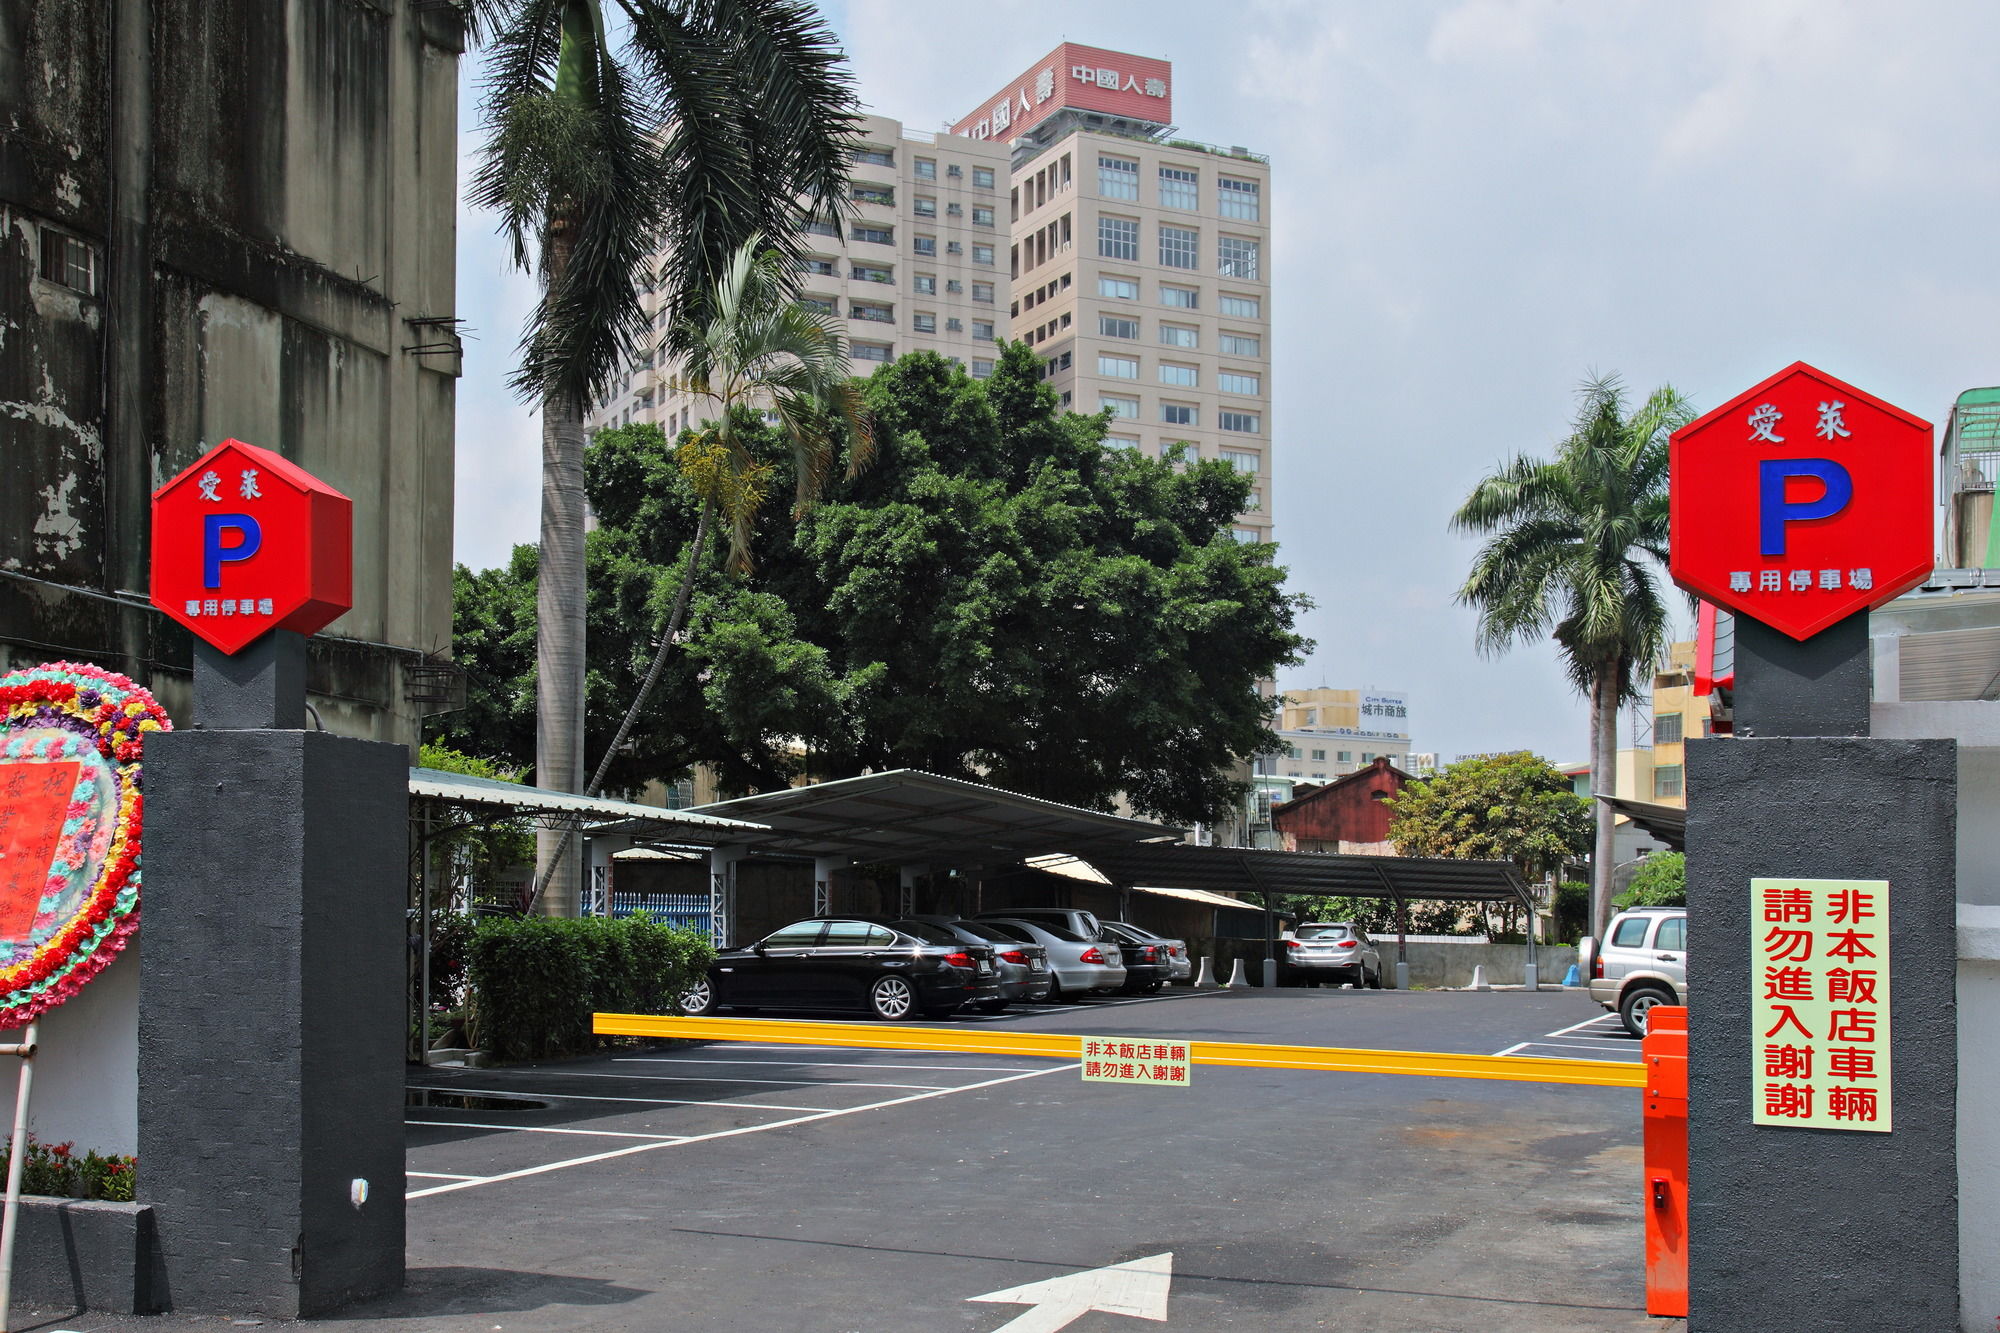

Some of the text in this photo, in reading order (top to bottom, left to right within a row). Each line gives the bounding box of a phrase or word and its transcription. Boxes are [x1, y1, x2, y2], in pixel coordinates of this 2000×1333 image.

[1072, 65, 1166, 98] 中國人壽
[972, 66, 1055, 141] 中國人壽
[1747, 399, 1852, 443] 愛萊
[198, 468, 263, 502] 愛萊
[1760, 458, 1853, 556] P
[204, 513, 262, 588] P
[1728, 568, 1874, 592] 專用停車場
[184, 598, 274, 617] 專用停車場
[1361, 703, 1406, 718] 城市商旅
[1763, 887, 1815, 1118] 請勿進入謝謝
[1825, 888, 1879, 1122] 非本飯店車輛
[1086, 1041, 1186, 1062] 非本飯店車輛
[1086, 1061, 1186, 1082] 請勿進入謝謝
